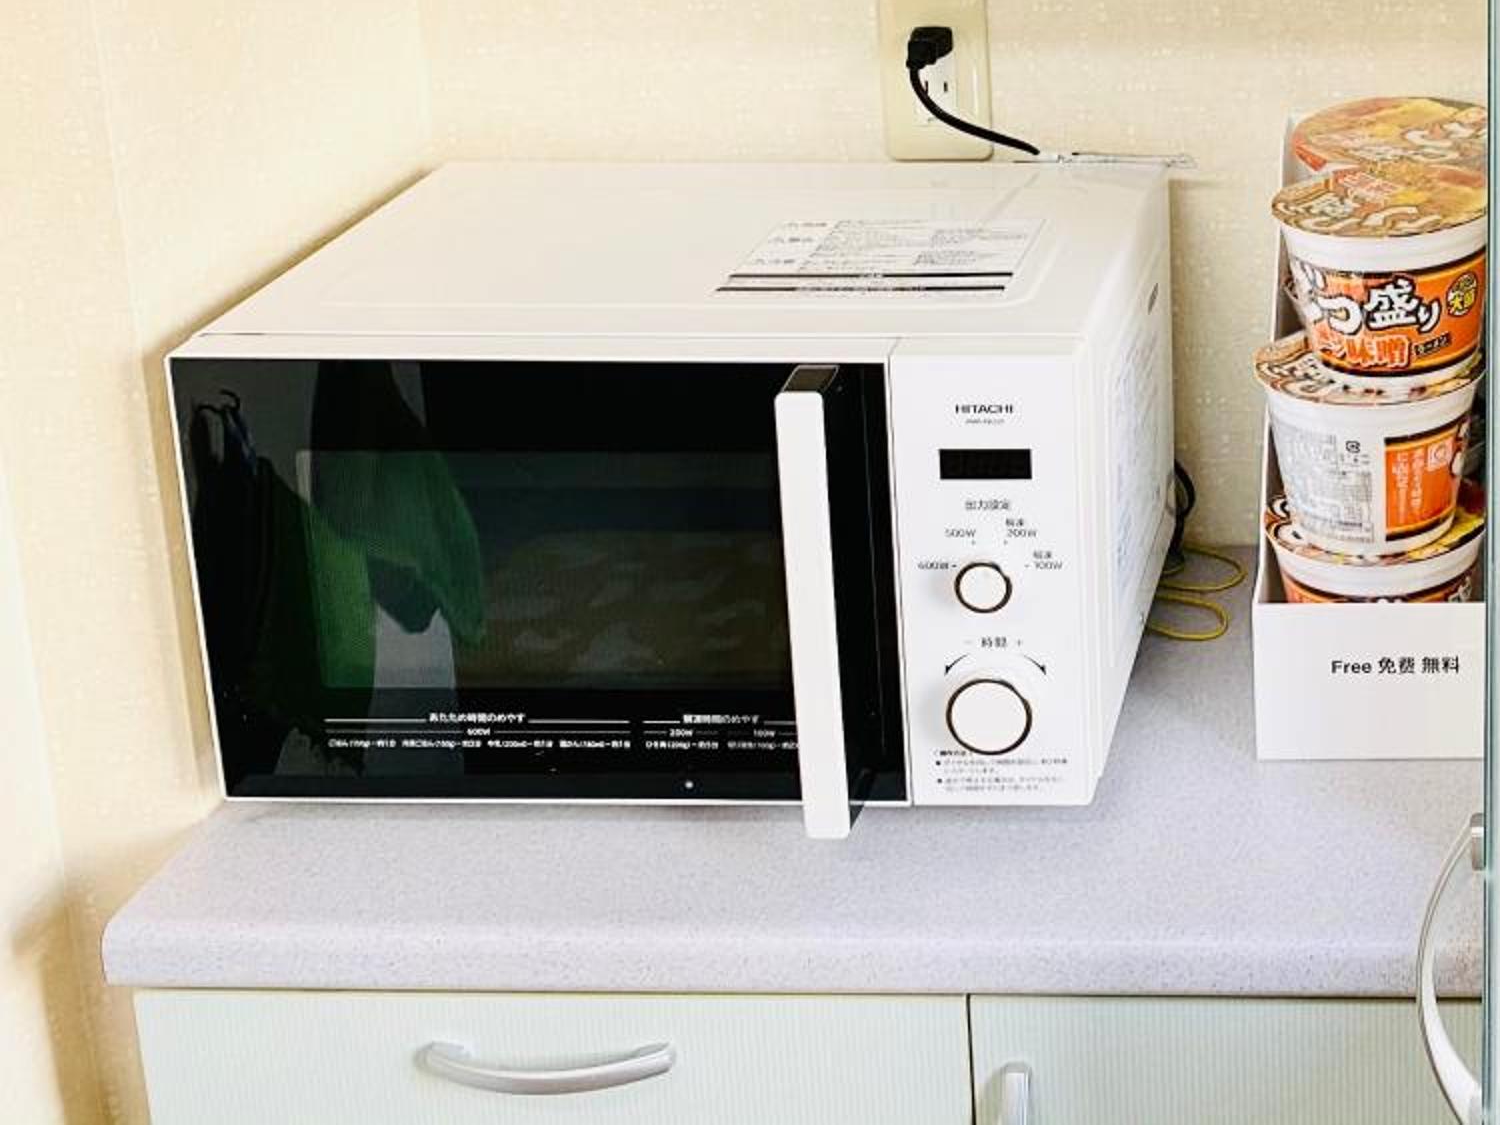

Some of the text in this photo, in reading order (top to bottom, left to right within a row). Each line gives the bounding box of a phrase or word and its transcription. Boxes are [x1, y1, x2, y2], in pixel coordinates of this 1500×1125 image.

[955, 404, 1014, 414] HITACHI
[1331, 660, 1372, 674] Free
[1421, 655, 1459, 674] 無料
